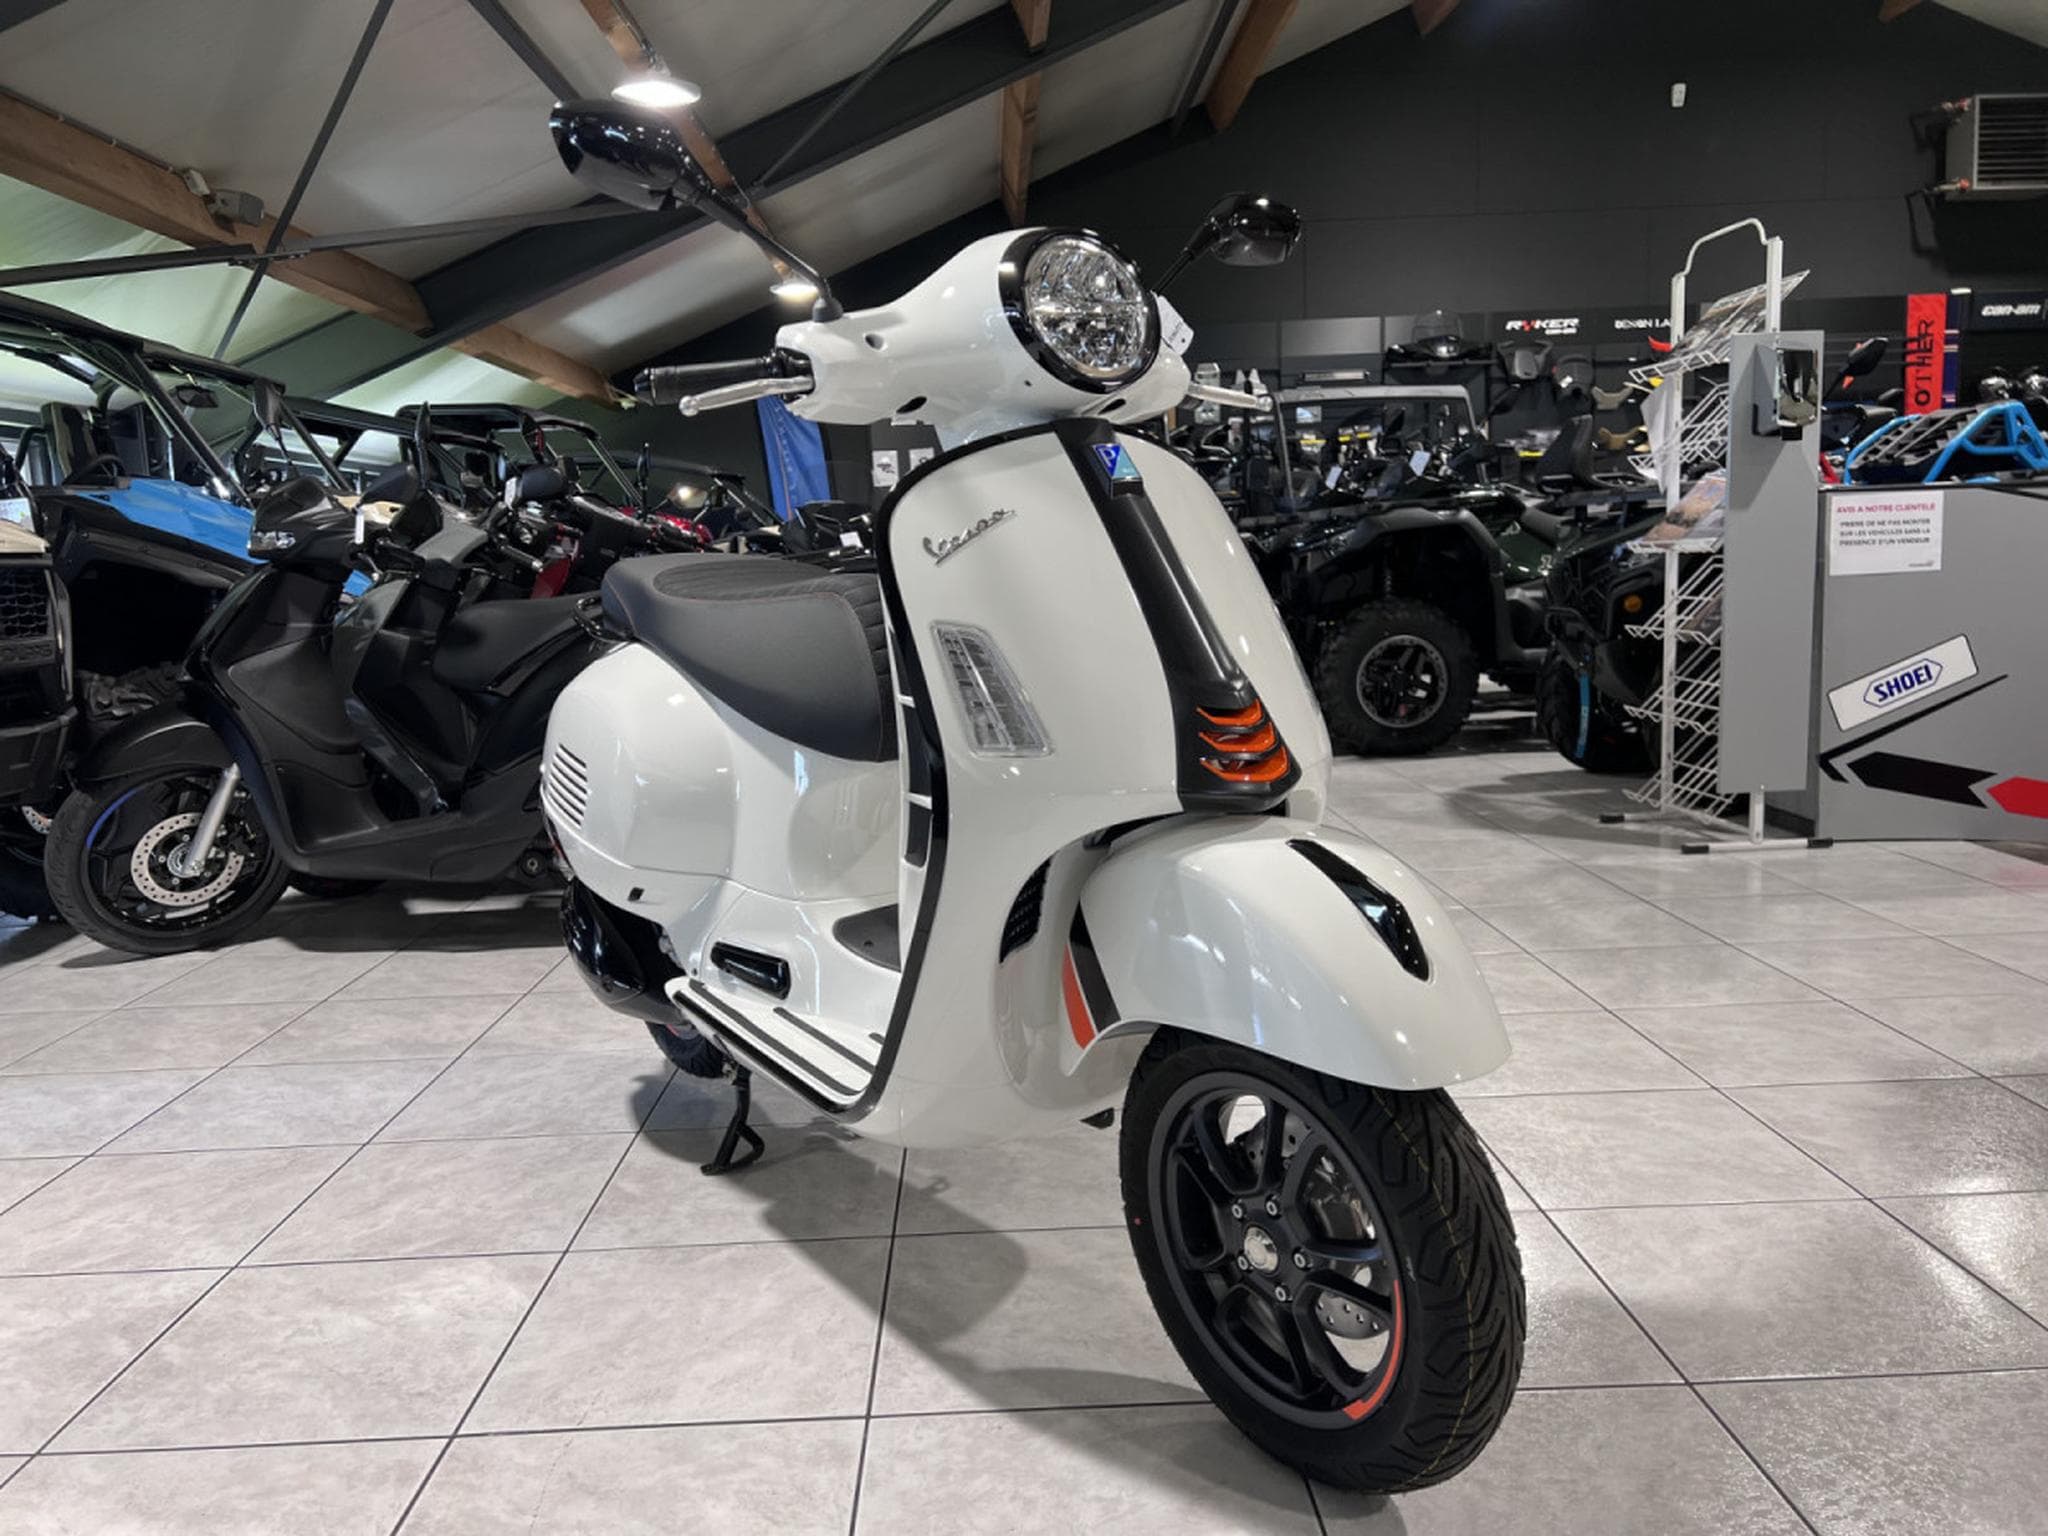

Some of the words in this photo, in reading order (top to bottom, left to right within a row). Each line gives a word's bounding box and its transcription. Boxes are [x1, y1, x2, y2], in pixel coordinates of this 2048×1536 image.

[1865, 504, 1893, 512] NOTRE
[922, 508, 1017, 566] Vespa
[1873, 664, 1933, 702] SHOEI
